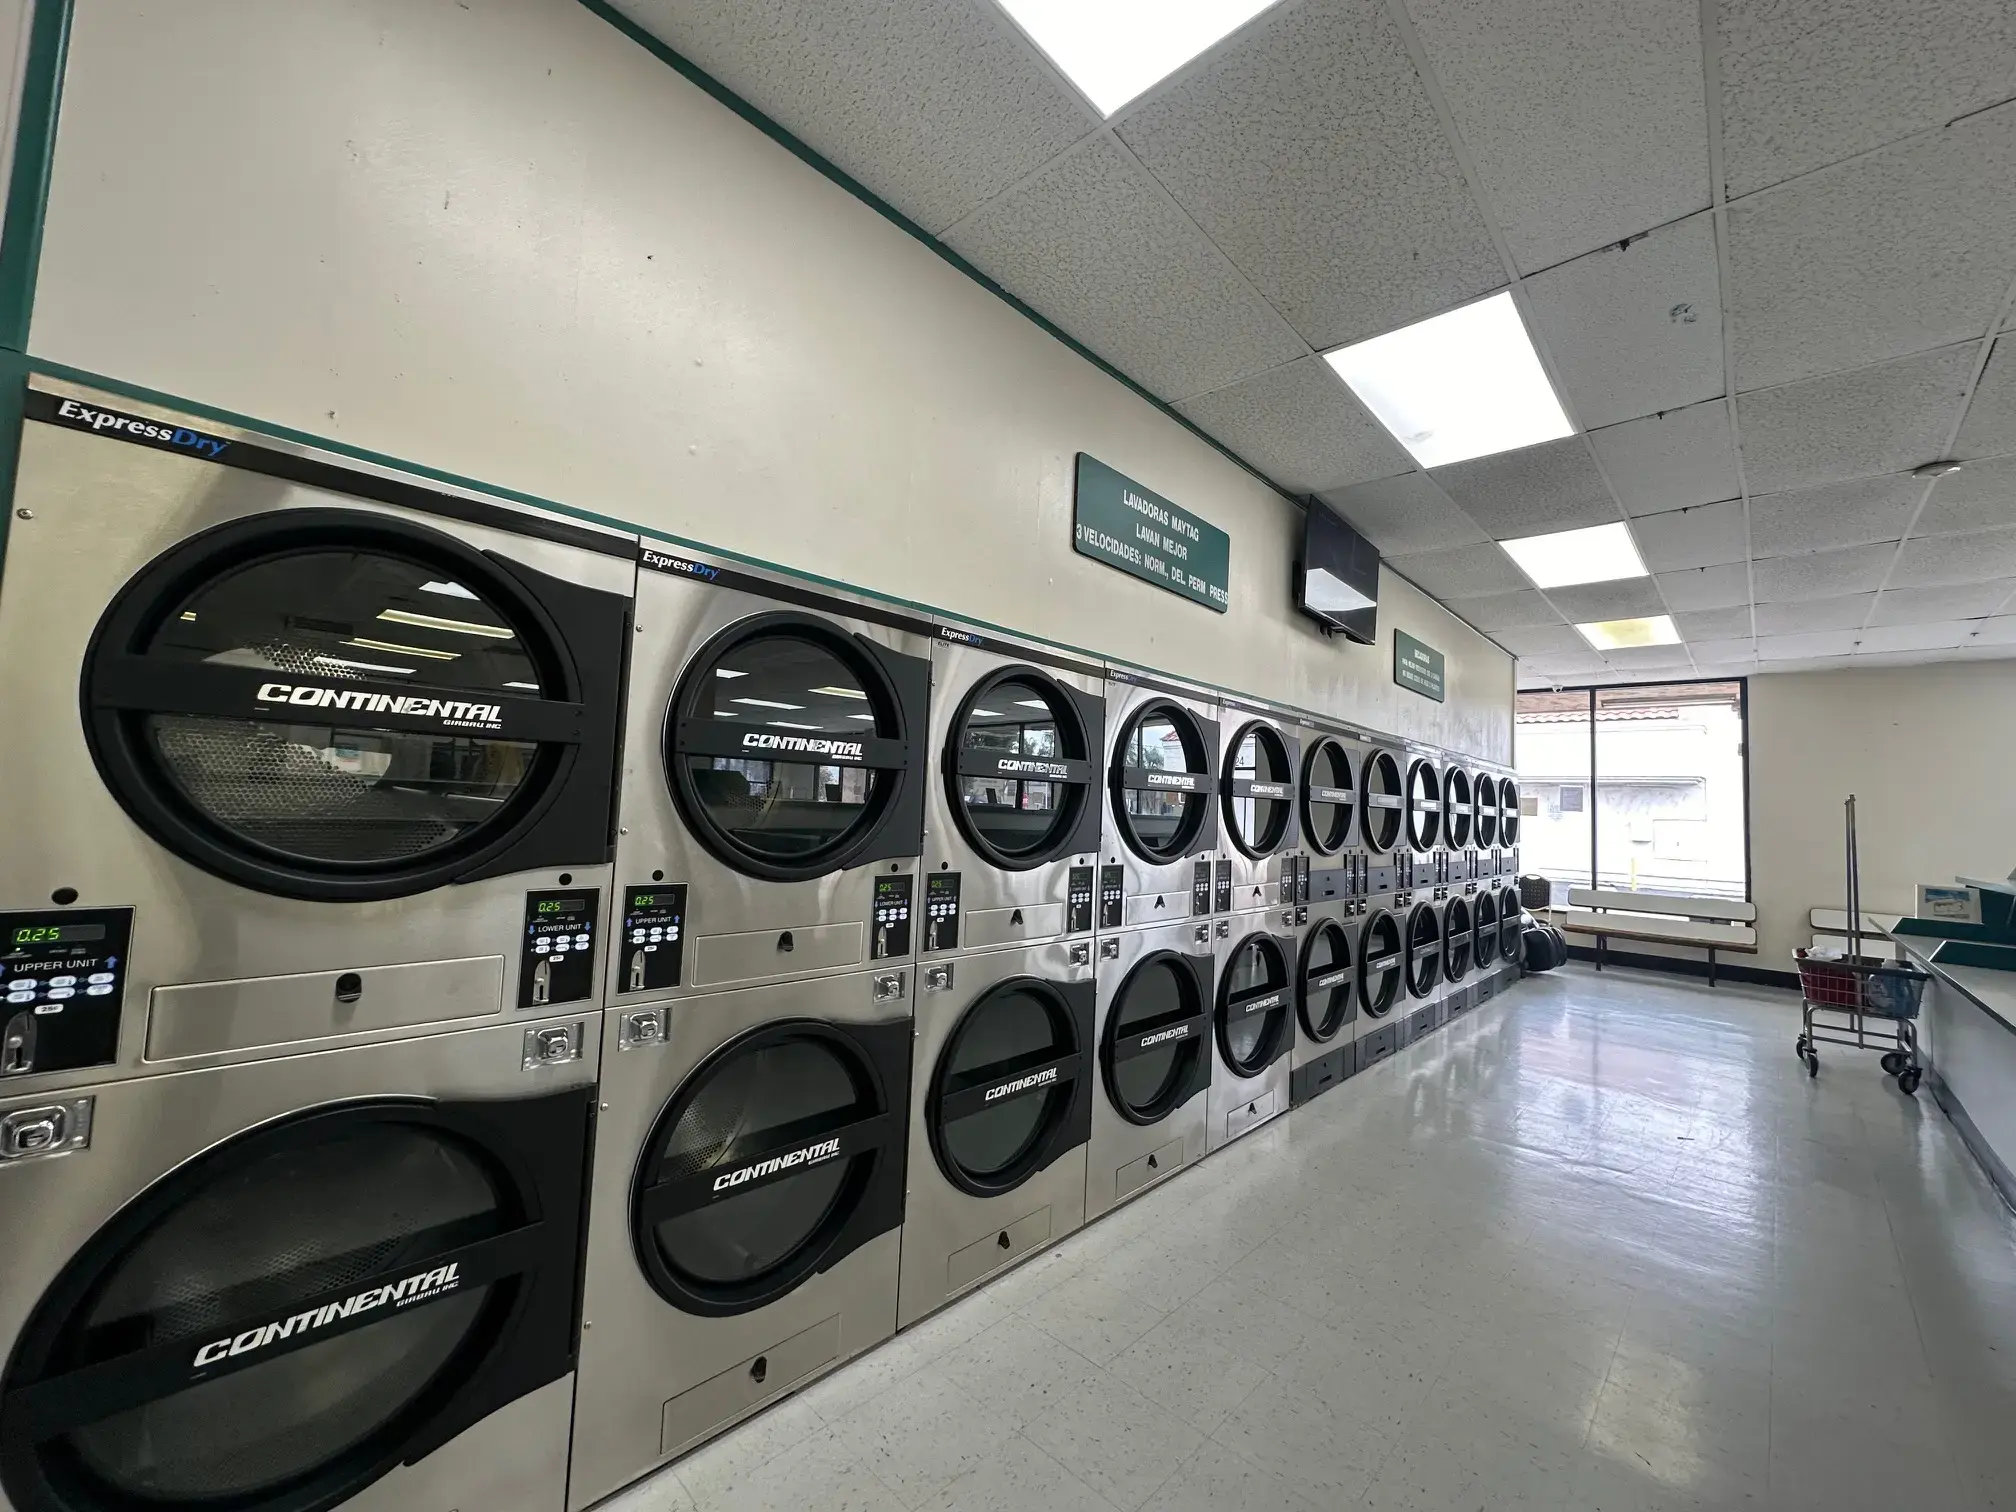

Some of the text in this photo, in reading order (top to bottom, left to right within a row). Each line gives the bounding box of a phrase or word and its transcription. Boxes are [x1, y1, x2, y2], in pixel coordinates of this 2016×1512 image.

[58, 400, 226, 457] ExpressDry
[1123, 489, 1199, 542] LAVADORAS MAYTAG
[1136, 523, 1188, 560] LAVAN MEJOR
[642, 550, 719, 580] ExpressDry
[1076, 523, 1082, 540] 3
[1083, 525, 1142, 565] VELOCIDADES:
[1188, 574, 1206, 594] PERM
[1209, 584, 1229, 605] PRESS
[941, 627, 984, 647] ExpressDry
[257, 683, 502, 723] CONTINENTAL
[443, 719, 502, 730] GIRBAU INC
[742, 733, 863, 756] CONTINENTAL
[998, 759, 1067, 775] CONTINENTAL
[16, 927, 61, 943] 0.25
[538, 923, 582, 933] LOWER UNIT
[14, 958, 99, 973] UPPER UNIT
[1141, 1024, 1189, 1047] CONTINENTAL
[985, 1067, 1057, 1101] CONTINENTAL
[713, 1137, 840, 1191] CONTINENTAL
[396, 1281, 459, 1307] GIRBAU INC
[193, 1262, 460, 1367] CONTINENTAL
